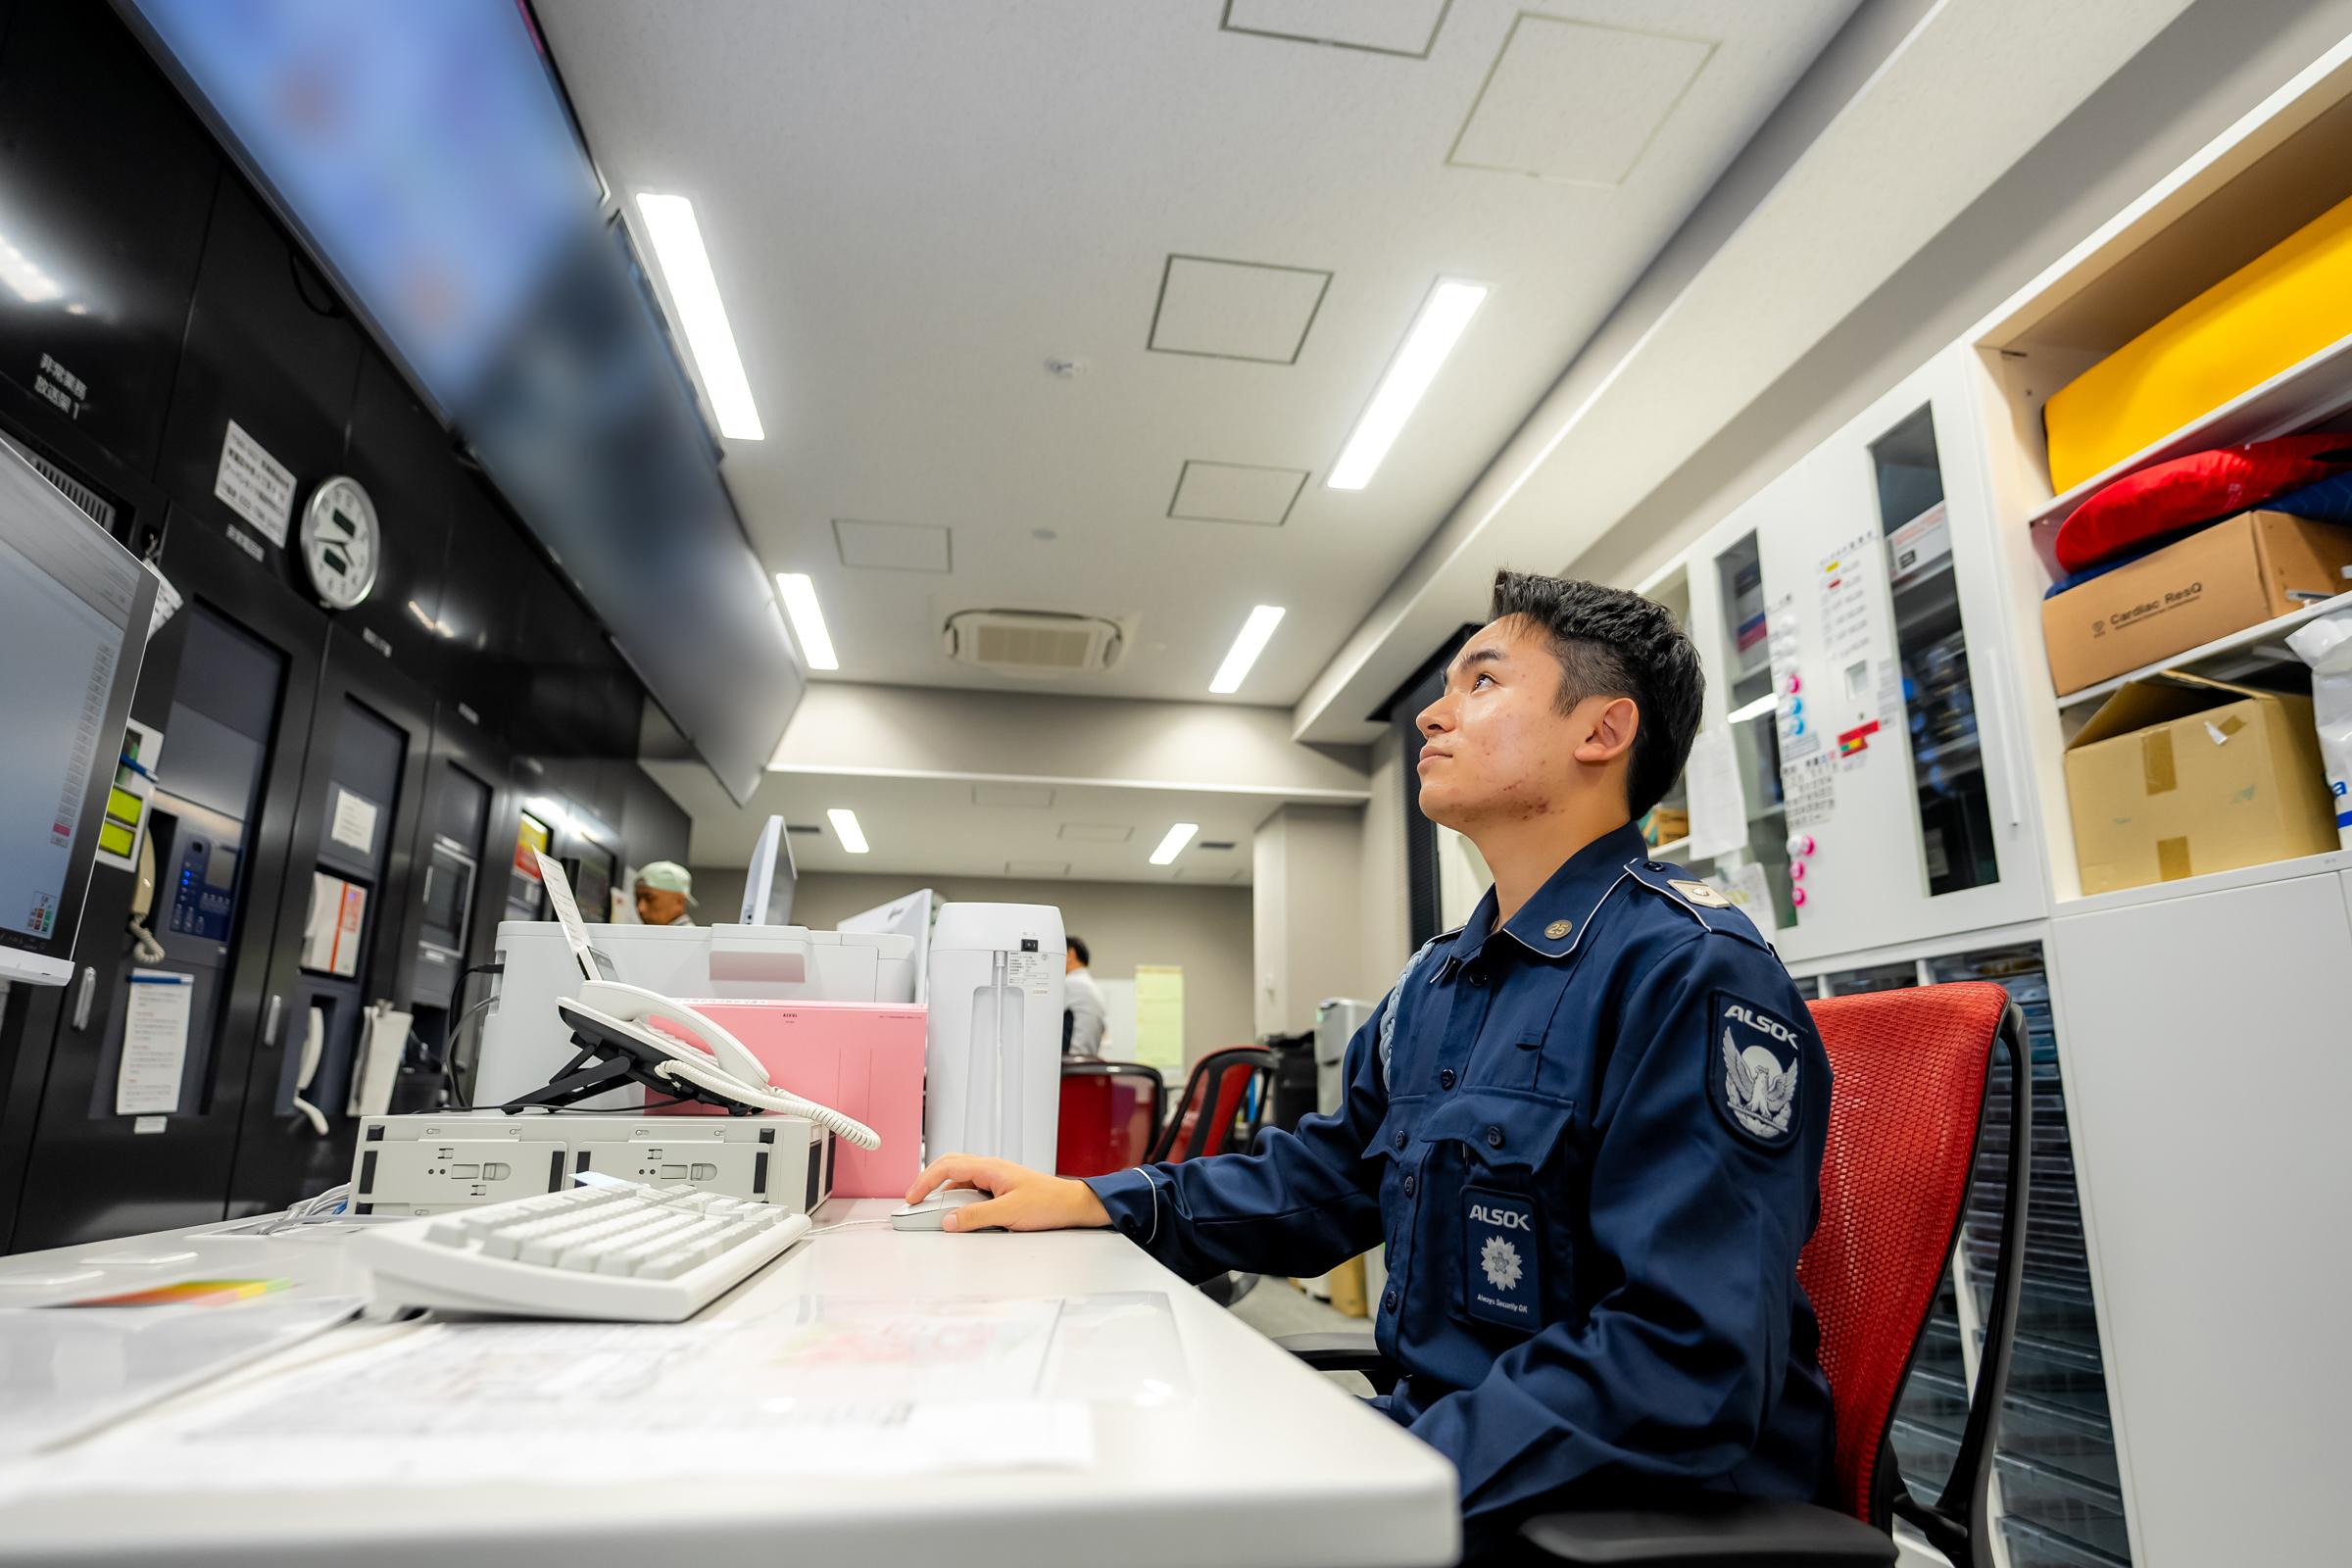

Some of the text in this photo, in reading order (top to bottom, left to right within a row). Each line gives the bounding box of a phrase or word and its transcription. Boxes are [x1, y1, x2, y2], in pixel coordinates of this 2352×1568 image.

[2110, 581, 2203, 625] Cardiac ResQ
[1546, 922, 1569, 935] 25
[1724, 1004, 1798, 1051] ALSOK
[1469, 1204, 1531, 1232] ALSOK
[1477, 1293, 1529, 1314] Always Security OK
